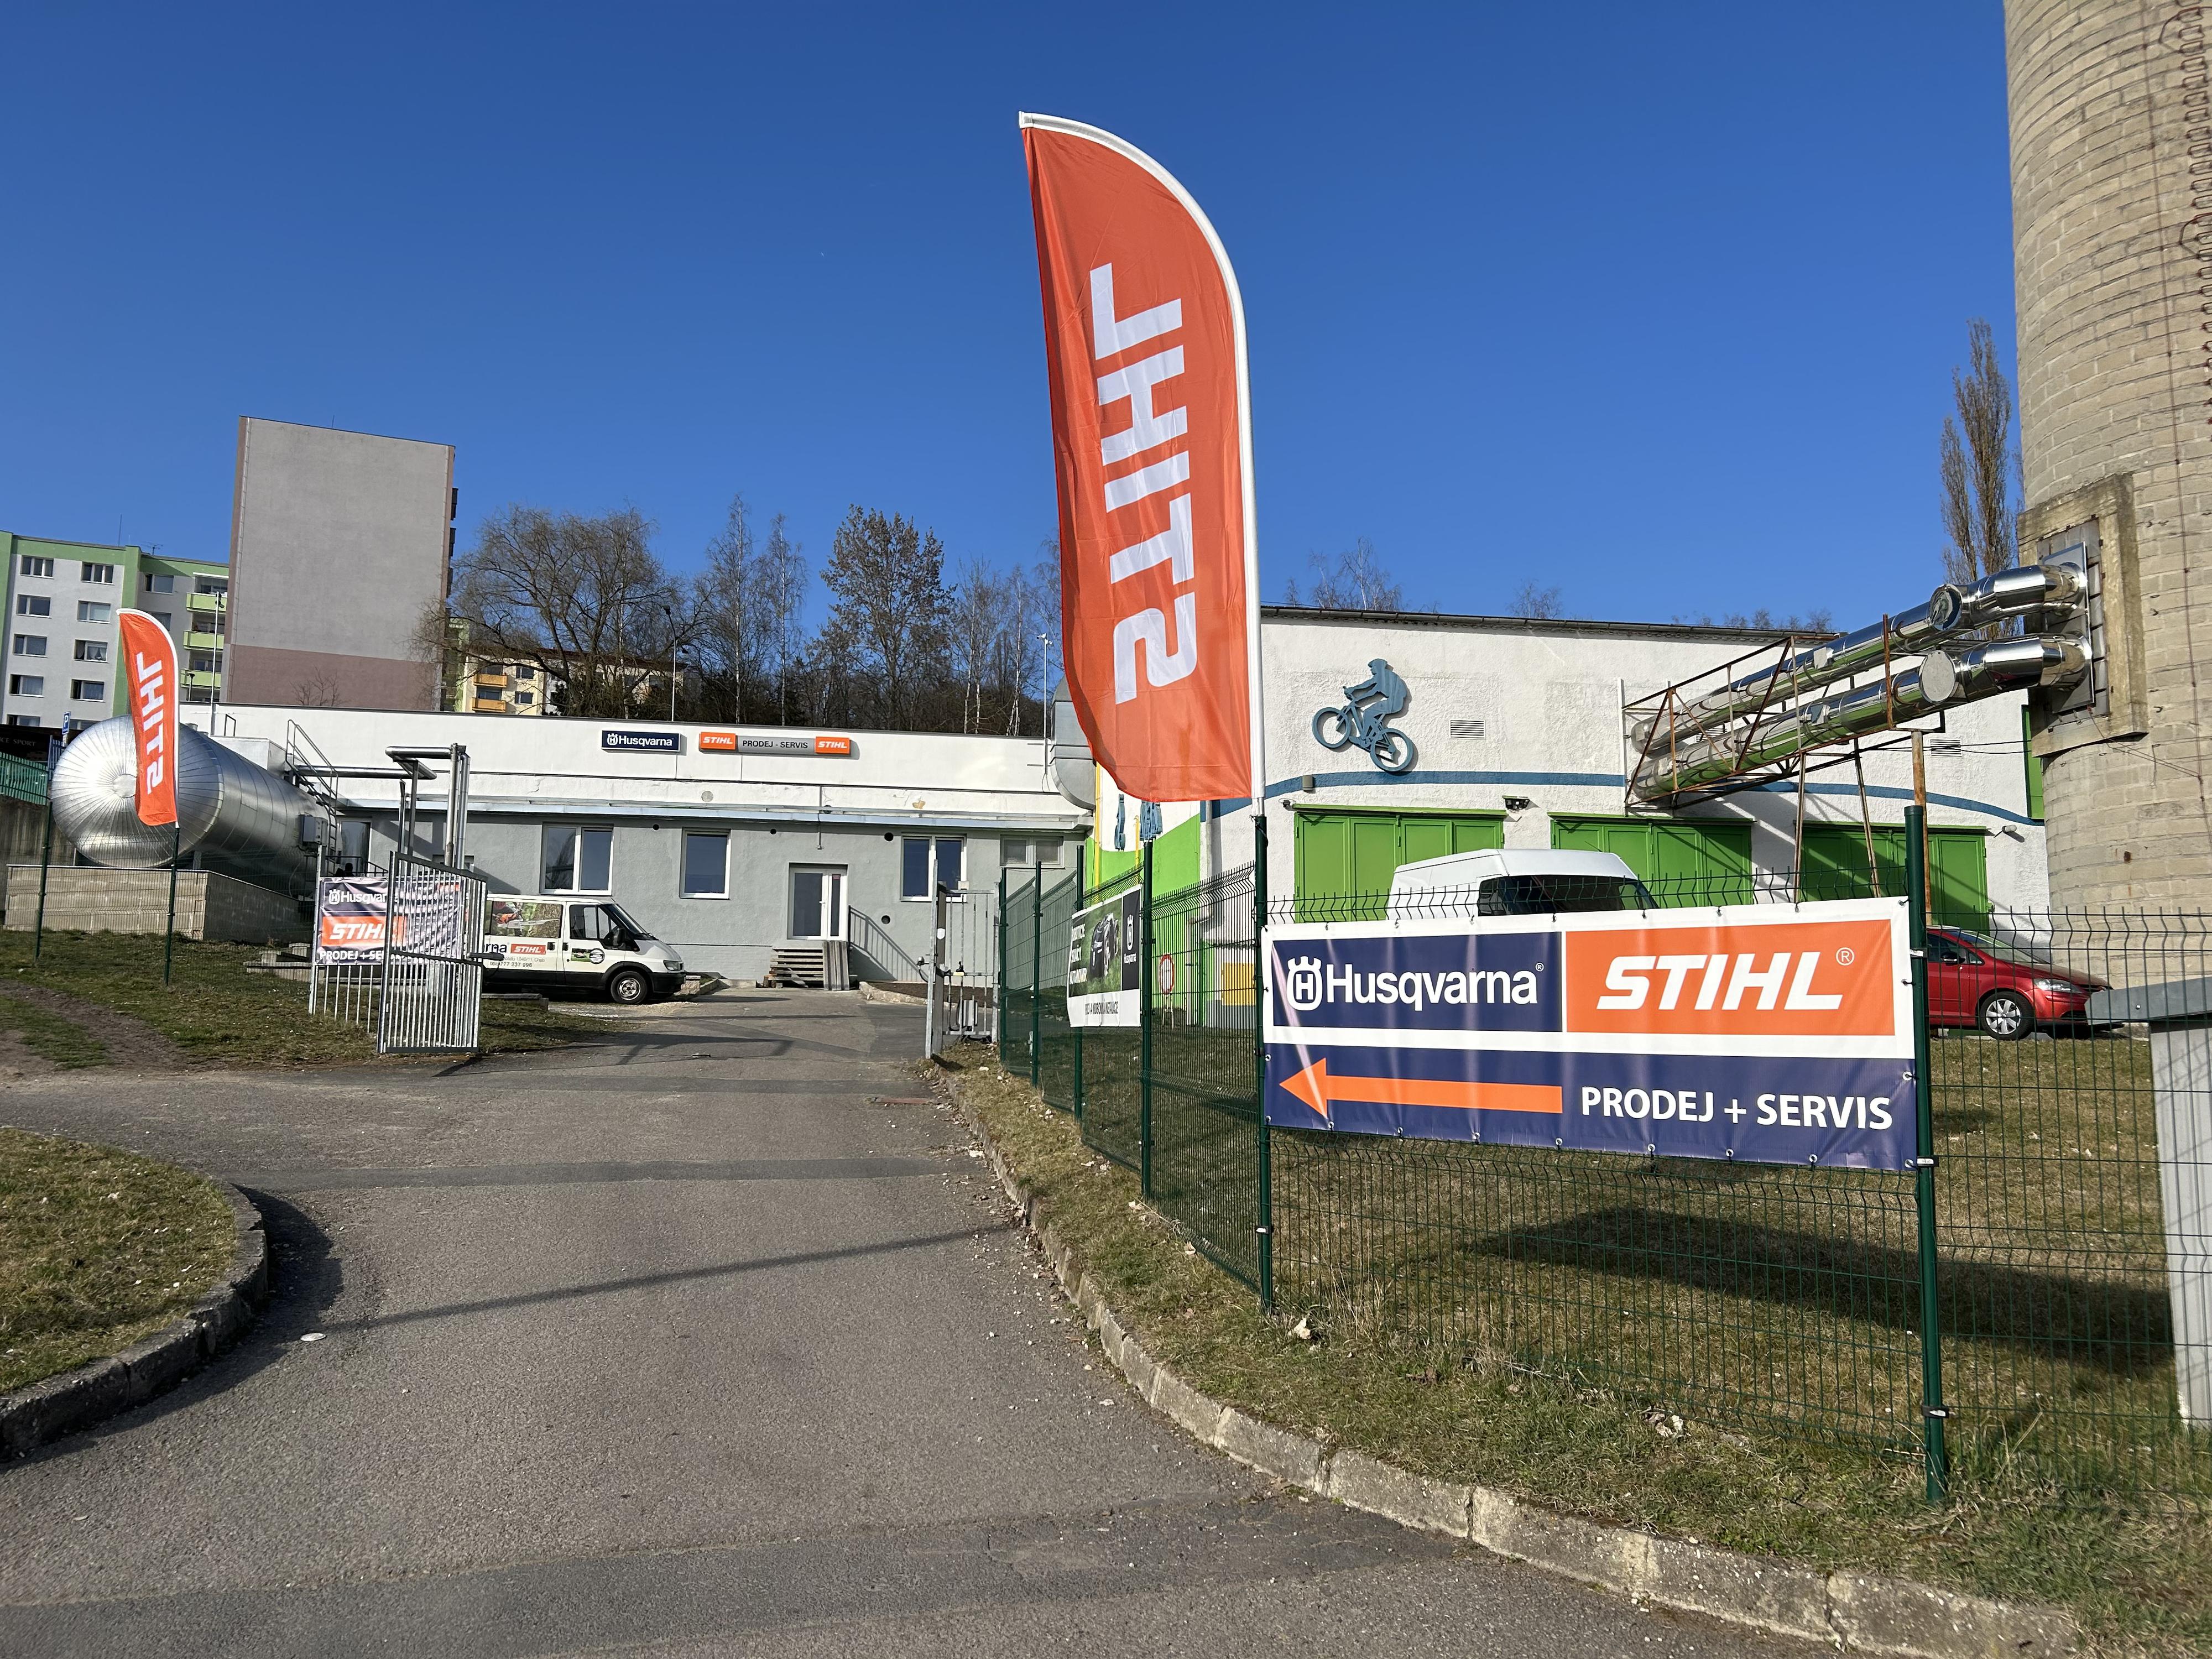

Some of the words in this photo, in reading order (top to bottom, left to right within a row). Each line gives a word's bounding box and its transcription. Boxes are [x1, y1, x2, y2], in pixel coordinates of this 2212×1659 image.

[64, 715, 68, 728] P
[619, 735, 673, 747] Husqvarna
[703, 736, 733, 745] STIHL
[320, 950, 358, 960] PRODEJ
[1327, 963, 1538, 1011] Husqvarna
[1597, 951, 1843, 1010] STIHL
[1582, 1086, 1714, 1122] PRODEJ
[1724, 1098, 1747, 1123] +
[1757, 1093, 1892, 1130] SERVIS
